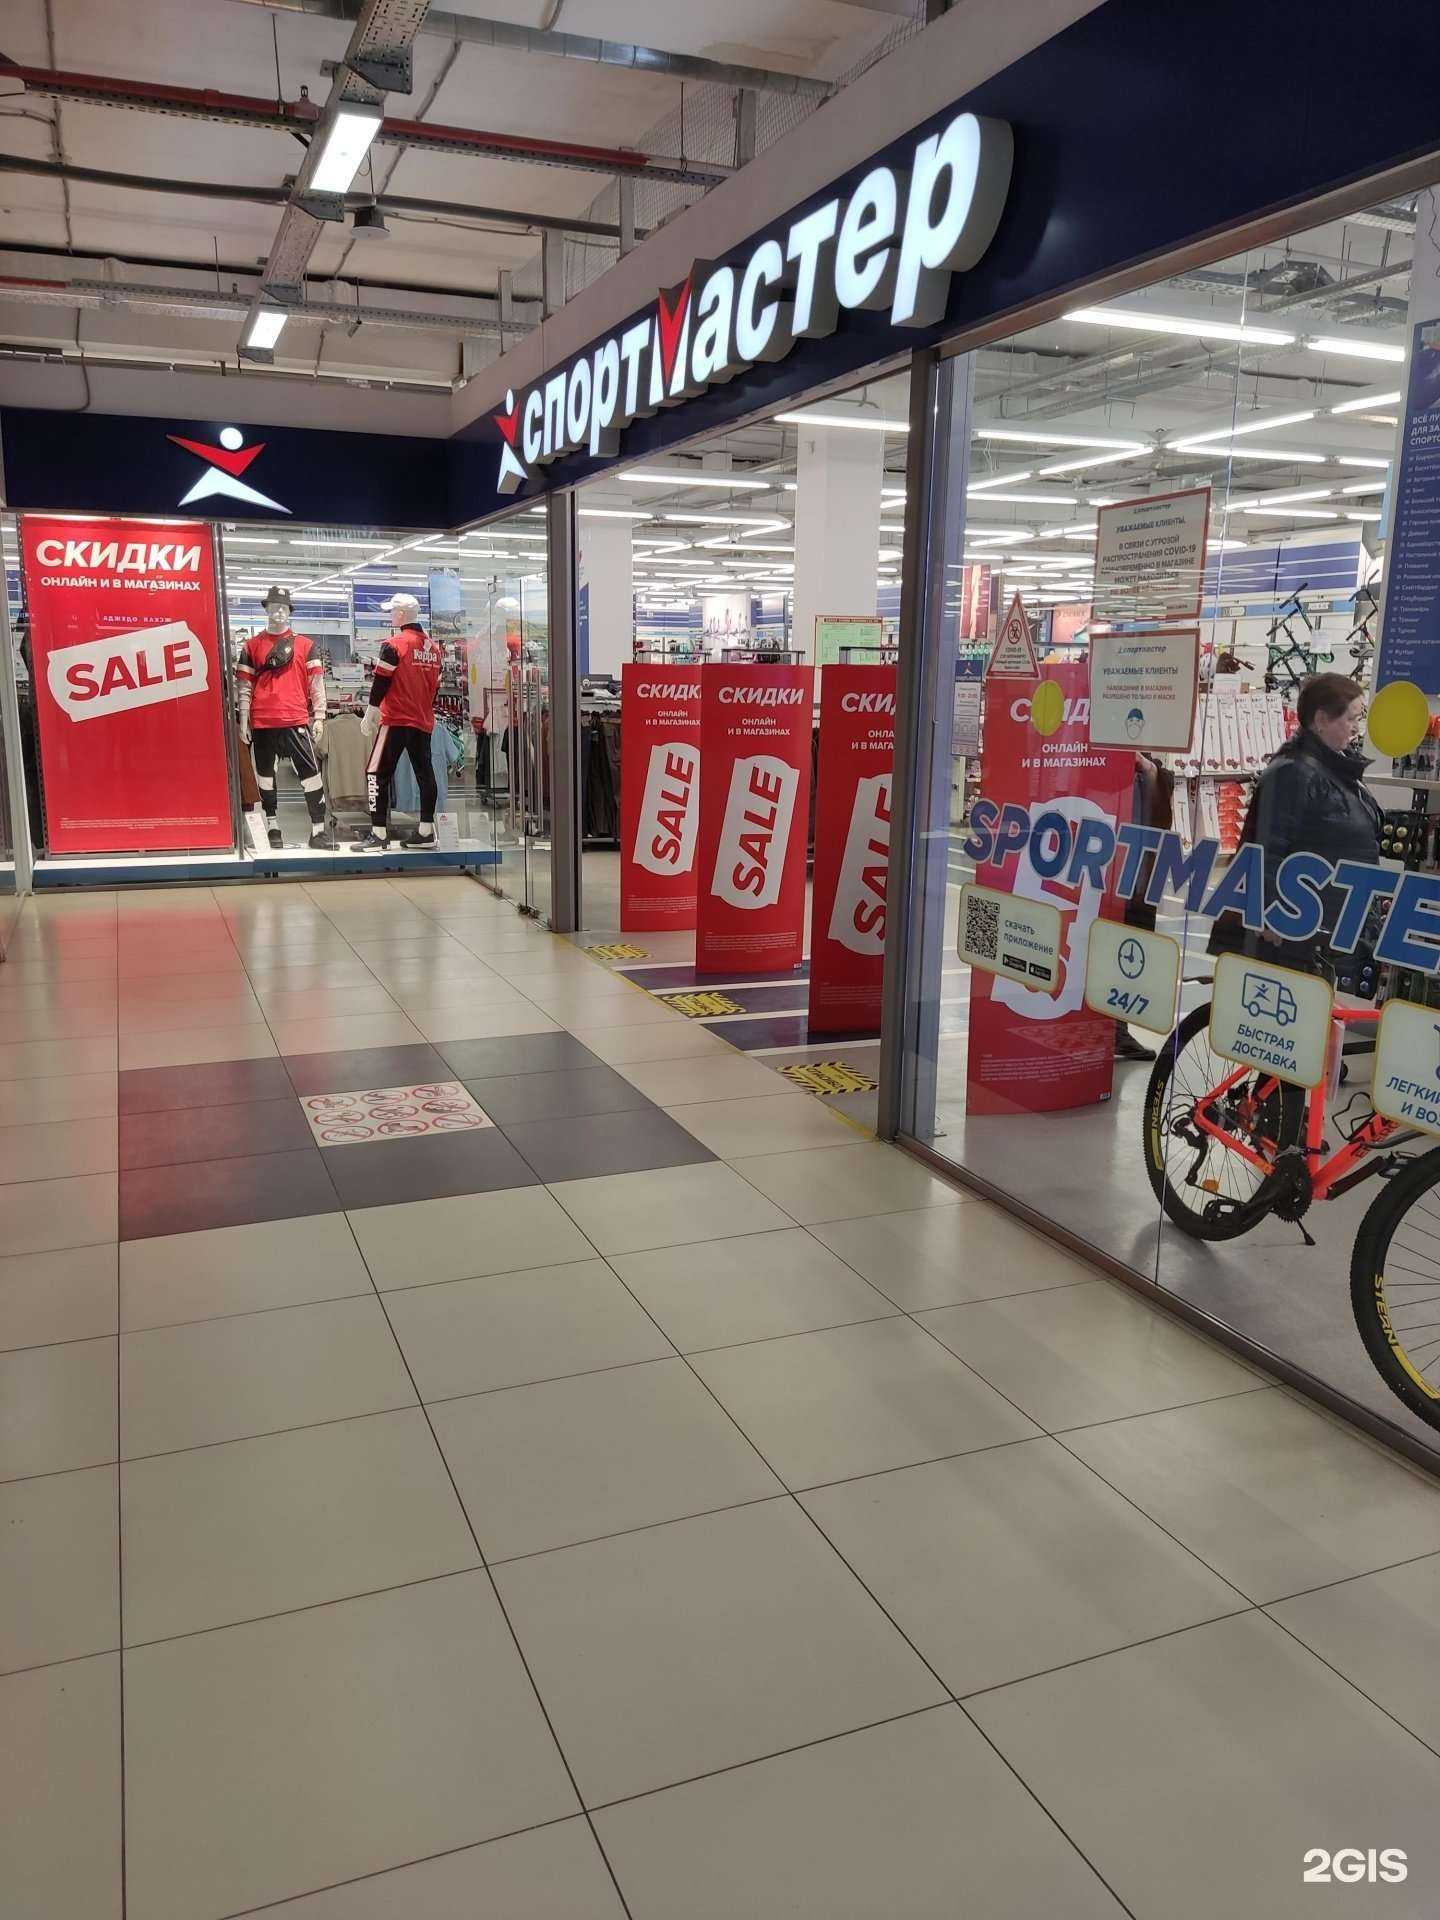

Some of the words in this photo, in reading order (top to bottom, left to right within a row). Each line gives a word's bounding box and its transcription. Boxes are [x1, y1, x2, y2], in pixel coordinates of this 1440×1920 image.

[36, 540, 201, 574] СКИДКИ
[41, 576, 97, 588] ОНЛАЙН
[100, 579, 110, 588] И
[113, 579, 121, 589] В
[125, 580, 201, 591] МАГАЗИНАХ
[66, 640, 192, 701] SALE
[637, 683, 702, 701] СКИДК
[718, 686, 804, 708] СКИДКИ
[657, 710, 688, 718] ОНЛАЙН
[742, 717, 776, 726] ОНЛАЙН
[743, 728, 791, 736] МАГАЗИНАХ
[852, 742, 859, 750] И
[861, 742, 867, 750] В
[1042, 742, 1088, 753] ОНЛАЙН
[1022, 759, 1030, 768] И
[1033, 759, 1041, 768] В
[1043, 757, 1106, 768] МАГАЗИНАХ
[367, 774, 379, 812] Kappa
[651, 751, 694, 864] SALE
[732, 766, 782, 897] SALE
[1004, 918, 1036, 935] скачать
[1003, 931, 1054, 955] приложение
[1107, 988, 1149, 1015] 24/7
[1237, 1023, 1295, 1052] БЫСТРАЯ
[1231, 1040, 1297, 1073] ДОСТАВКА
[1151, 1080, 1164, 1129] STERN
[1401, 1101, 1413, 1115] И
[1373, 1273, 1399, 1347] STERN
